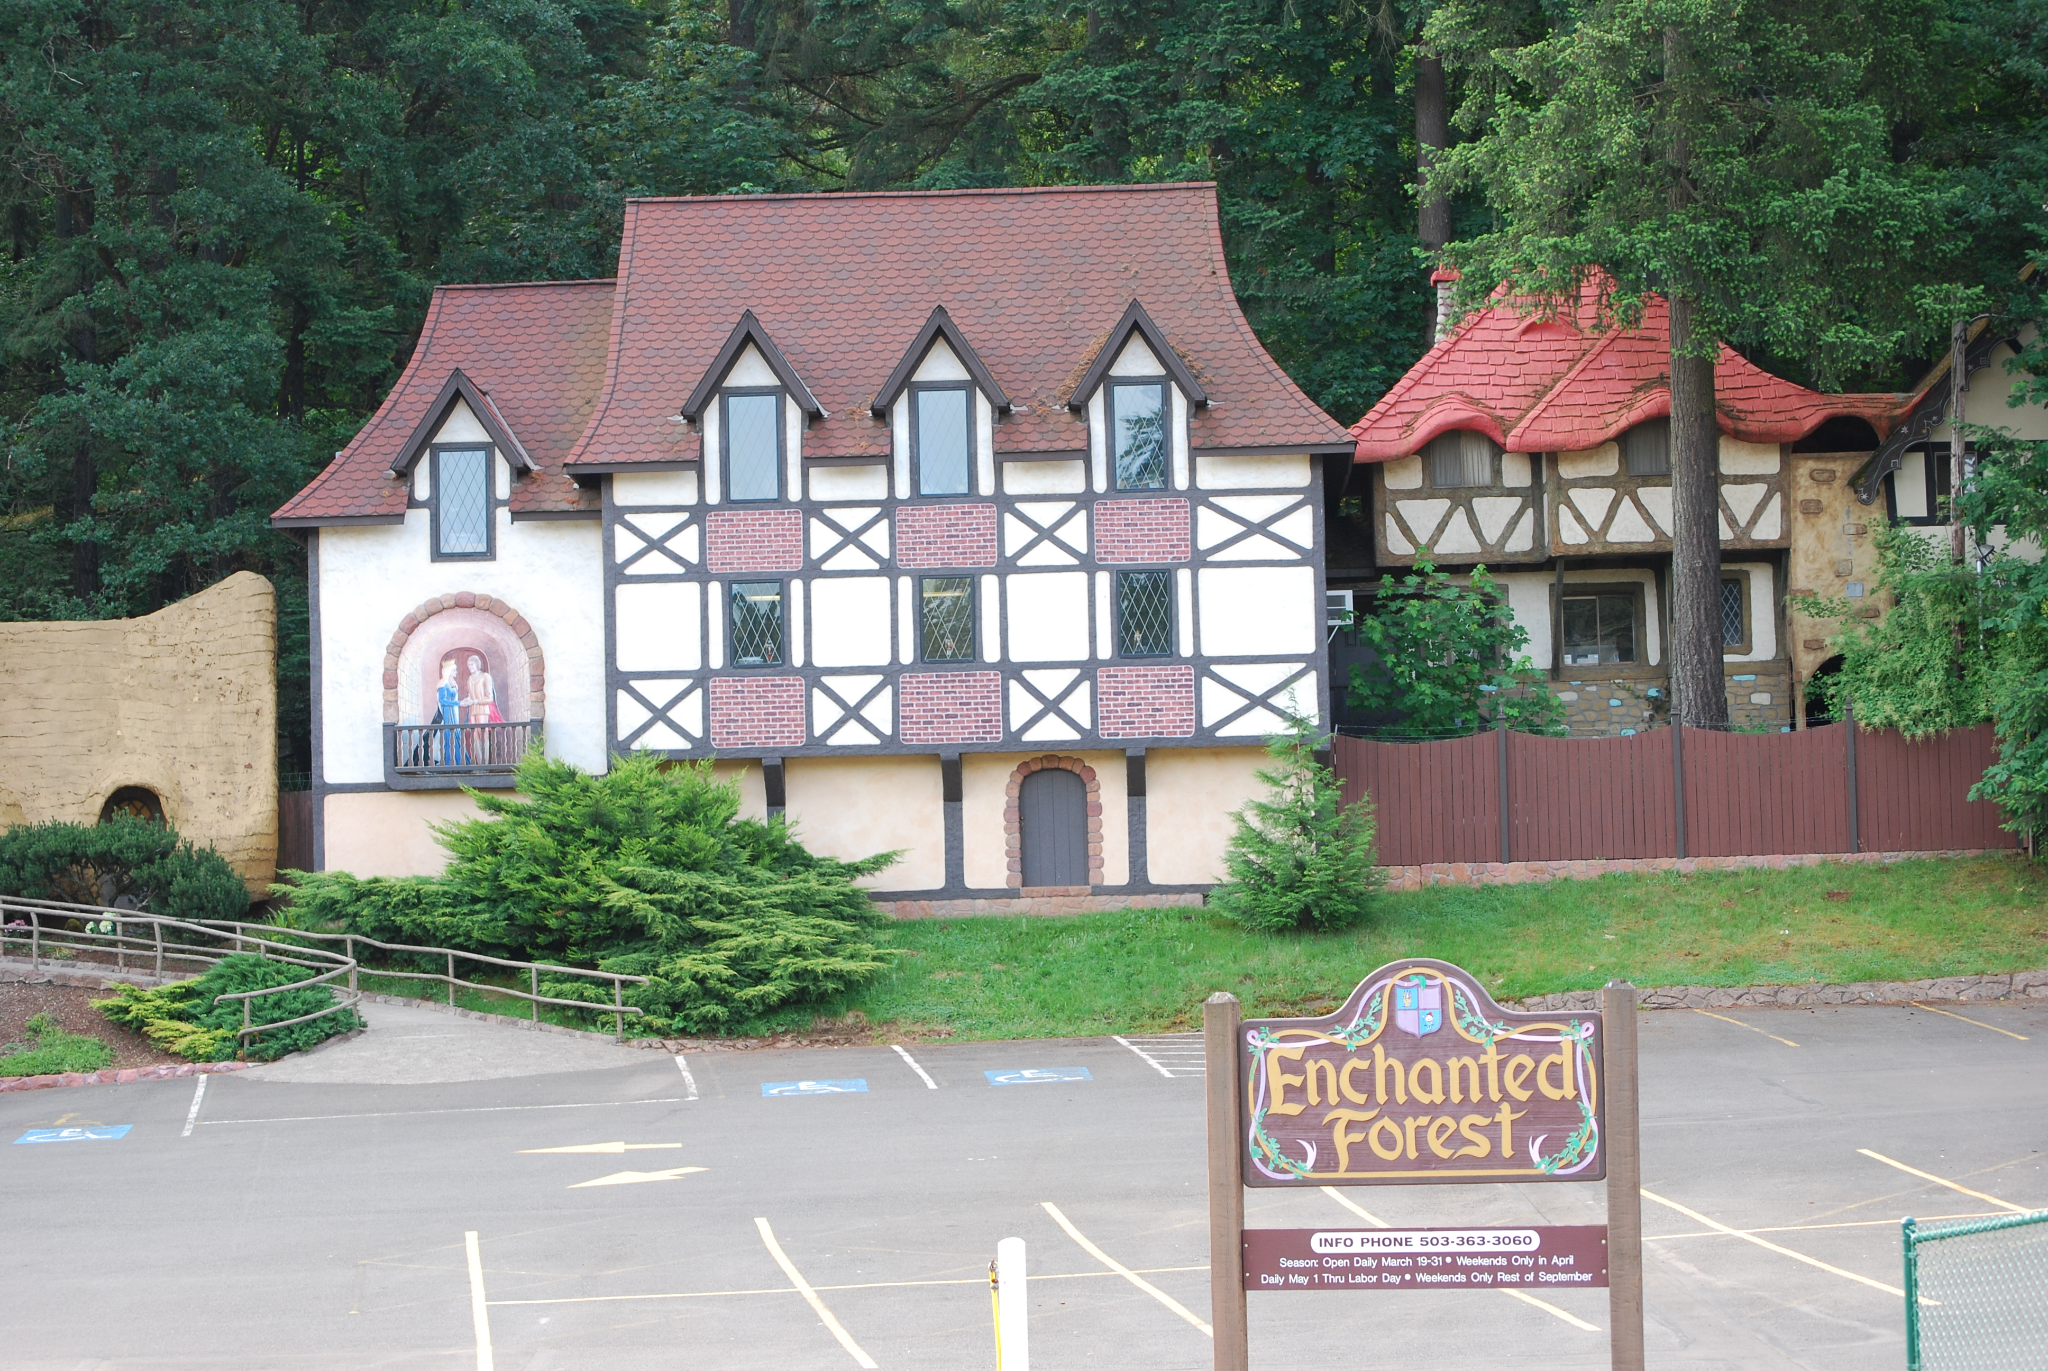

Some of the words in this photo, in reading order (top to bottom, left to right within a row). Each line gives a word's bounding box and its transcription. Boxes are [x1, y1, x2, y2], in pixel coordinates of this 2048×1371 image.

[1266, 1037, 1578, 1115] Enchanted
[1322, 1101, 1528, 1173] Forest
[1319, 1237, 1354, 1248] INFO
[1361, 1236, 1413, 1247] PHONE
[1420, 1235, 1533, 1247] 503-363-3060
[1279, 1257, 1319, 1268] Season:
[1322, 1257, 1350, 1269] Open
[1353, 1256, 1378, 1269] Daily
[1381, 1256, 1413, 1267] March
[1416, 1256, 1443, 1267] 19-31
[1456, 1255, 1508, 1267] Weekends
[1511, 1255, 1534, 1267] Only
[1538, 1255, 1547, 1266] in
[1551, 1254, 1574, 1267] April
[1261, 1273, 1285, 1286] Daily
[1288, 1273, 1309, 1286] May
[1313, 1273, 1319, 1284] 1
[1322, 1273, 1345, 1284] Thru
[1348, 1273, 1378, 1284] Labor
[1381, 1272, 1401, 1285] Day
[1415, 1271, 1467, 1283] Weekends
[1471, 1271, 1493, 1284] Only
[1497, 1271, 1520, 1283] Rest
[1524, 1271, 1535, 1282] of
[1538, 1270, 1593, 1283] September
